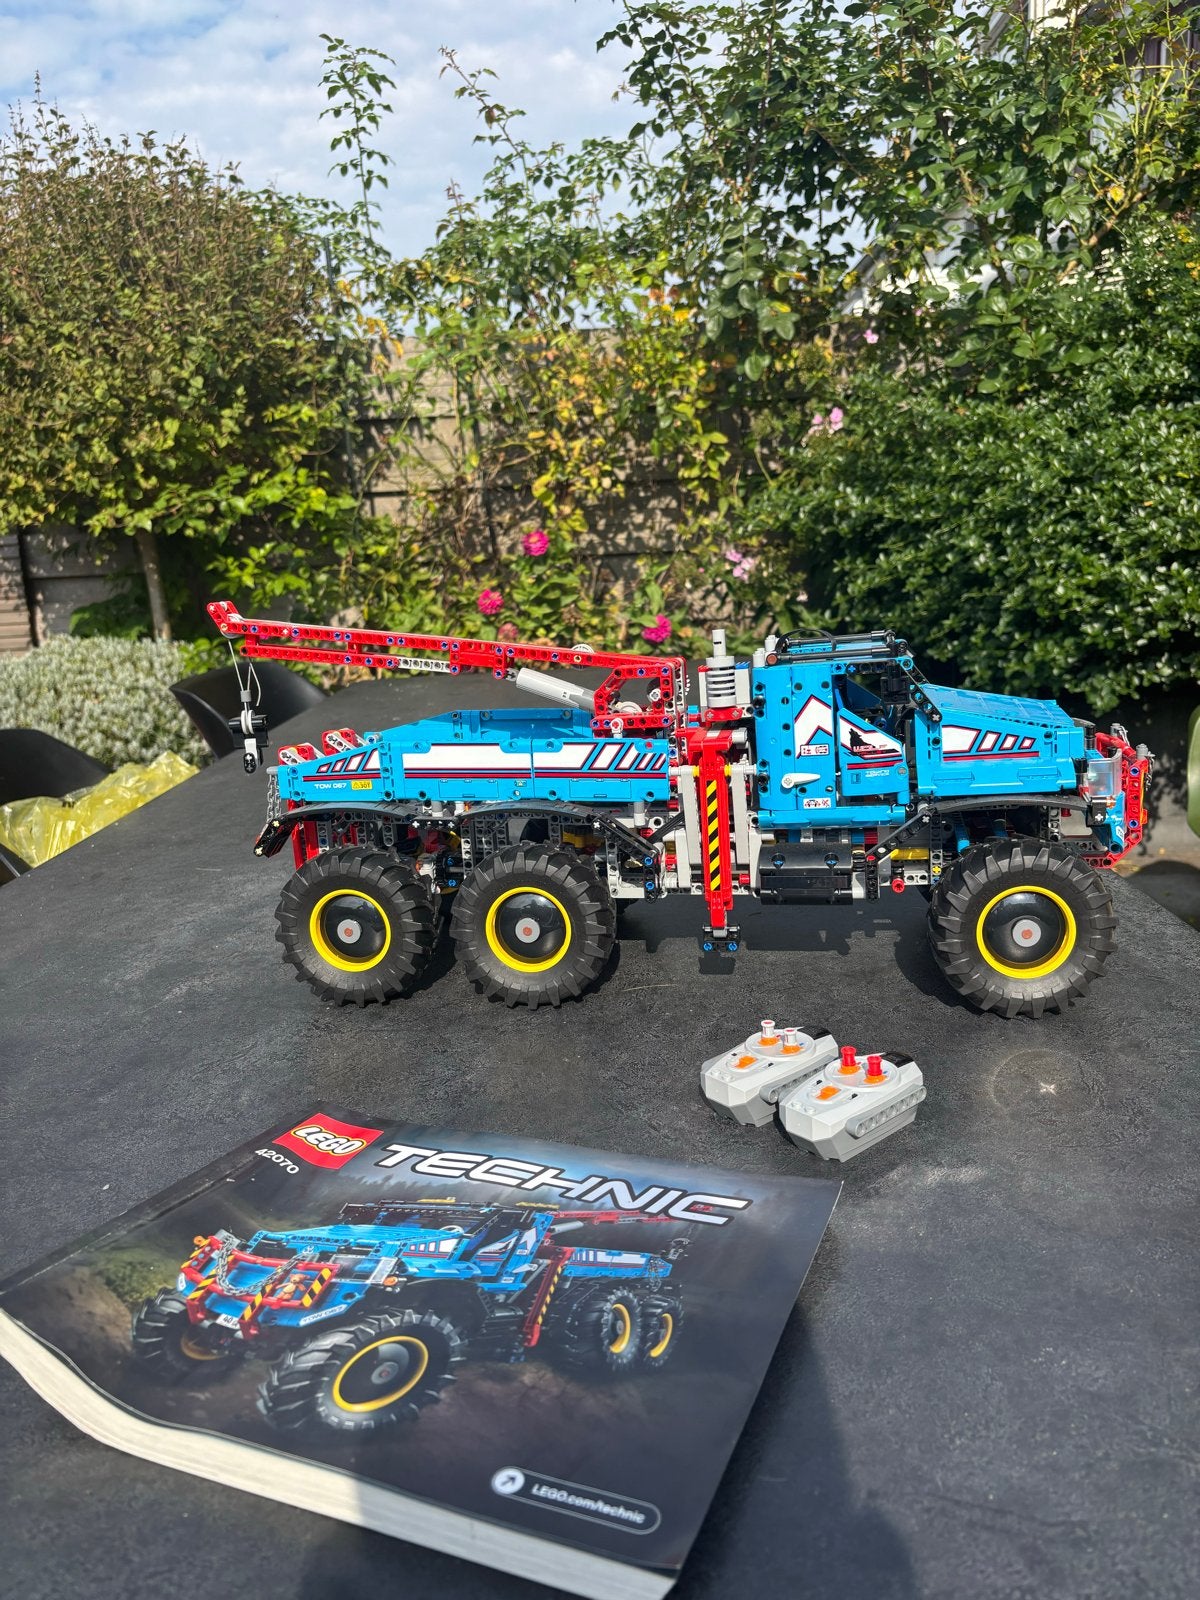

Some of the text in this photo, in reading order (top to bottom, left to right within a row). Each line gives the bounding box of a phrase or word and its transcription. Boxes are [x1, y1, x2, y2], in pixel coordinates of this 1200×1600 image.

[292, 1126, 366, 1155] LEGO
[254, 1148, 300, 1174] 42070
[377, 1143, 750, 1226] TECHNIC
[532, 1484, 646, 1524] LEGO.com/technic
